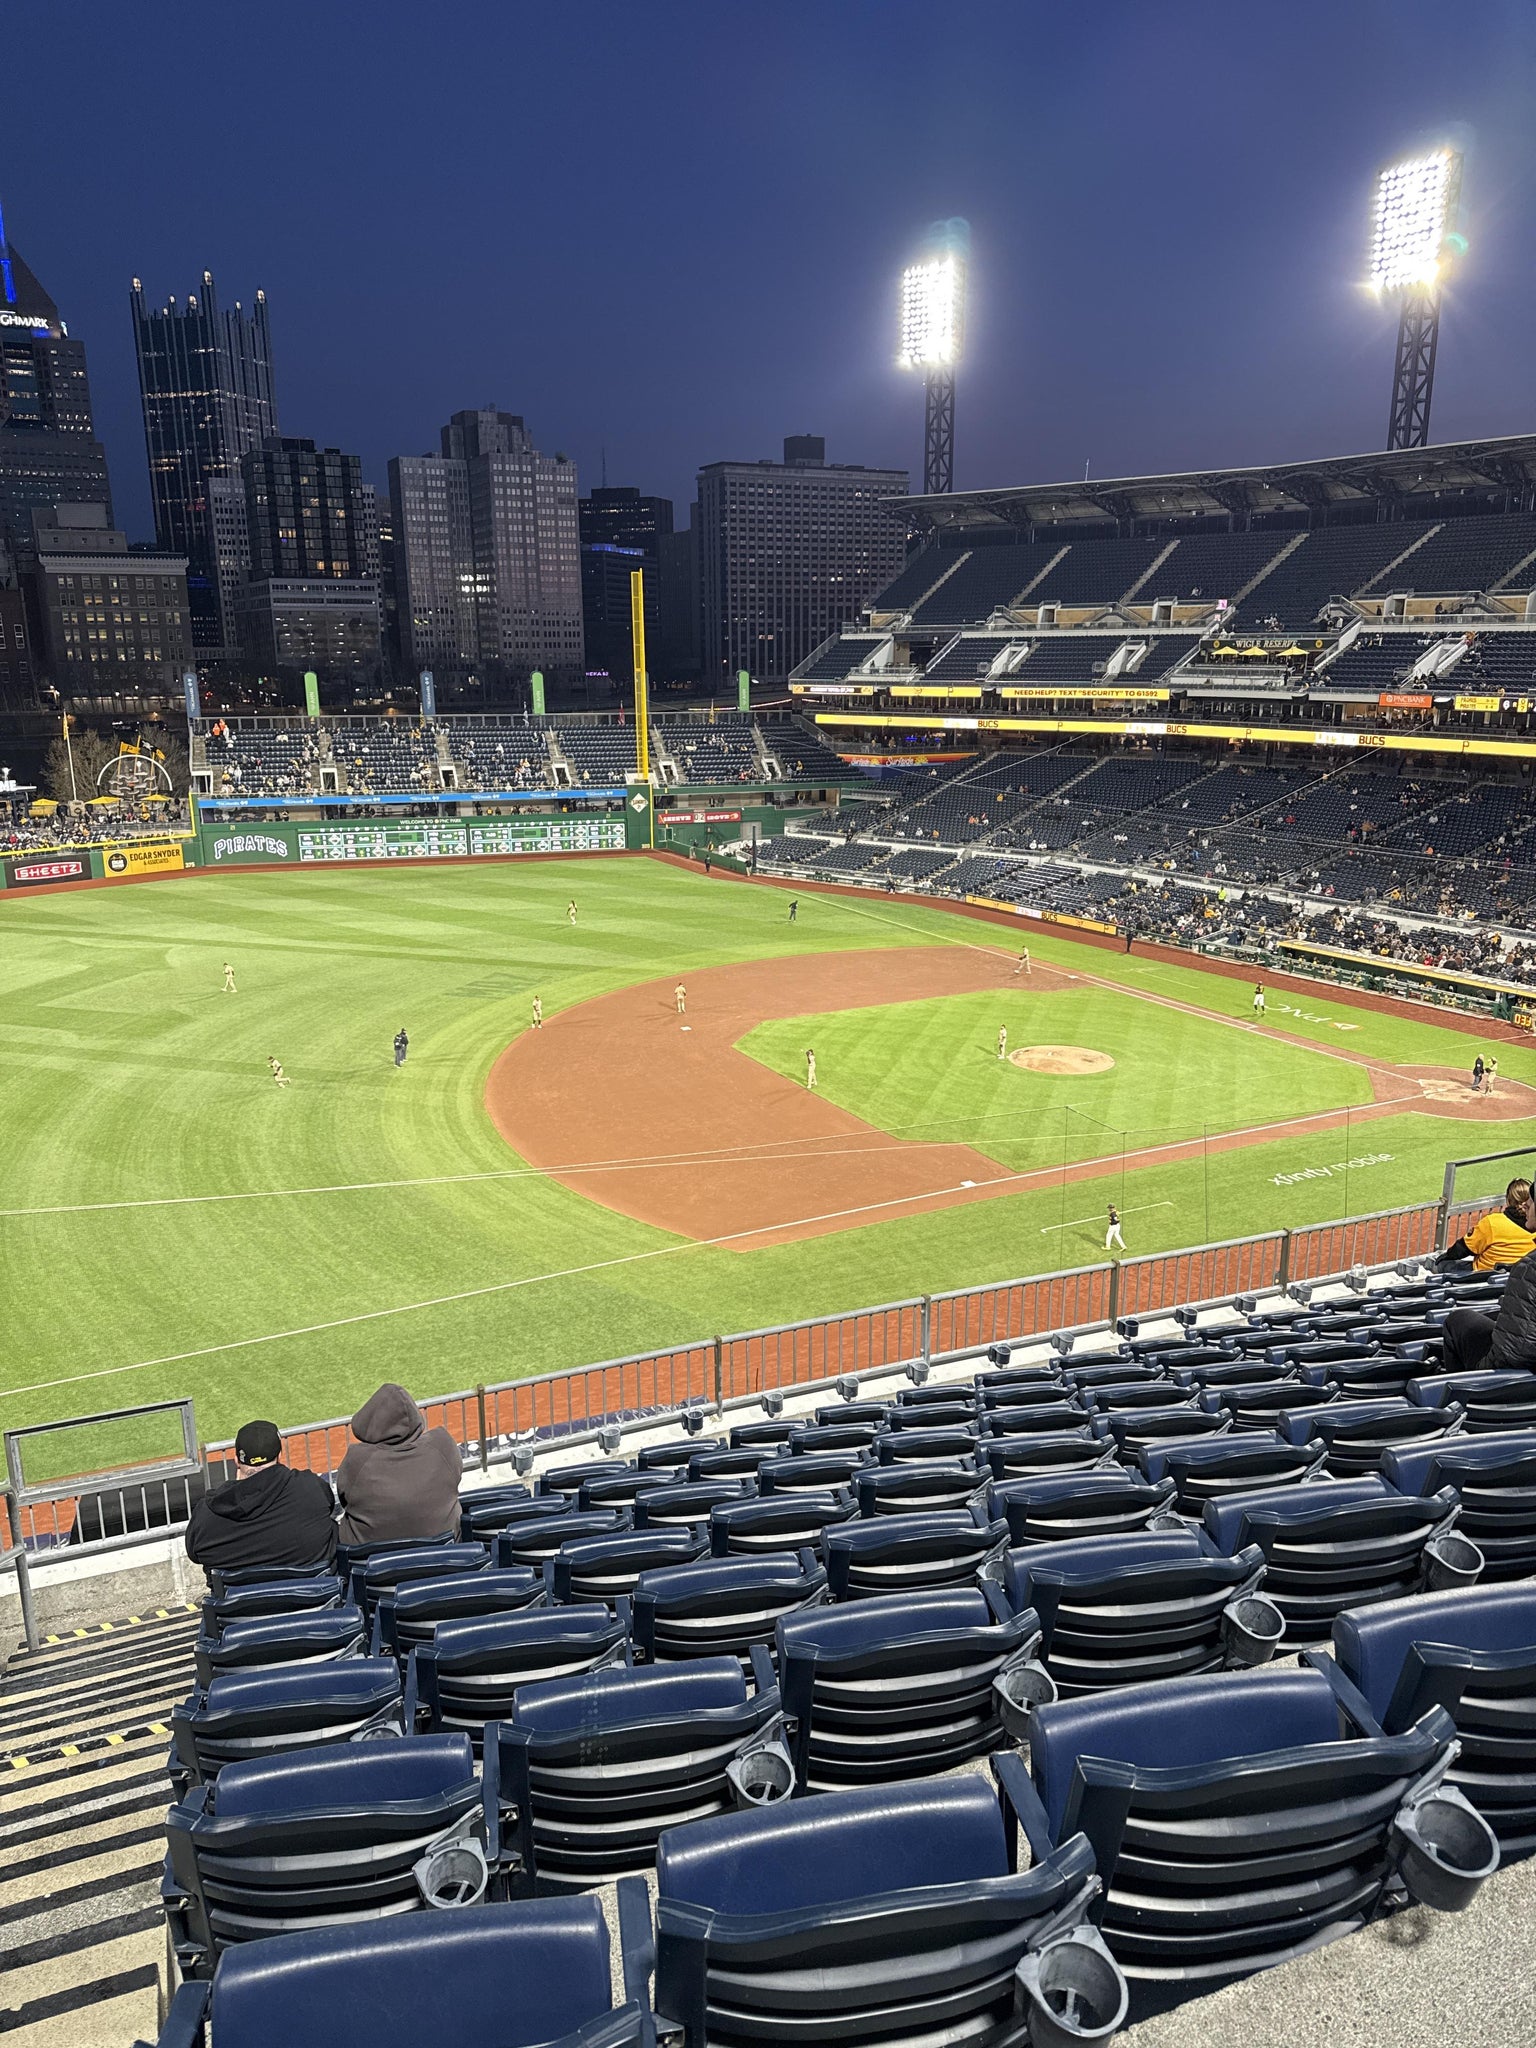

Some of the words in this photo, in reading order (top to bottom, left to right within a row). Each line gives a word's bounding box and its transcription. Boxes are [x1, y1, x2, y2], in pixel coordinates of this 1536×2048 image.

[1235, 640, 1262, 648] WIGLE
[1263, 640, 1298, 648] RESERVE
[977, 720, 998, 728] BUCS
[1166, 724, 1187, 734] BUCS
[1358, 735, 1386, 746] BUCS
[214, 835, 288, 860] PIRATES
[129, 852, 153, 862] EDGAR
[153, 848, 181, 859] SNYDER
[19, 864, 78, 878] SHEETZ
[1042, 911, 1058, 922] BUCS
[1266, 1166, 1333, 1186] xfinity
[1330, 1152, 1396, 1172] mobile
